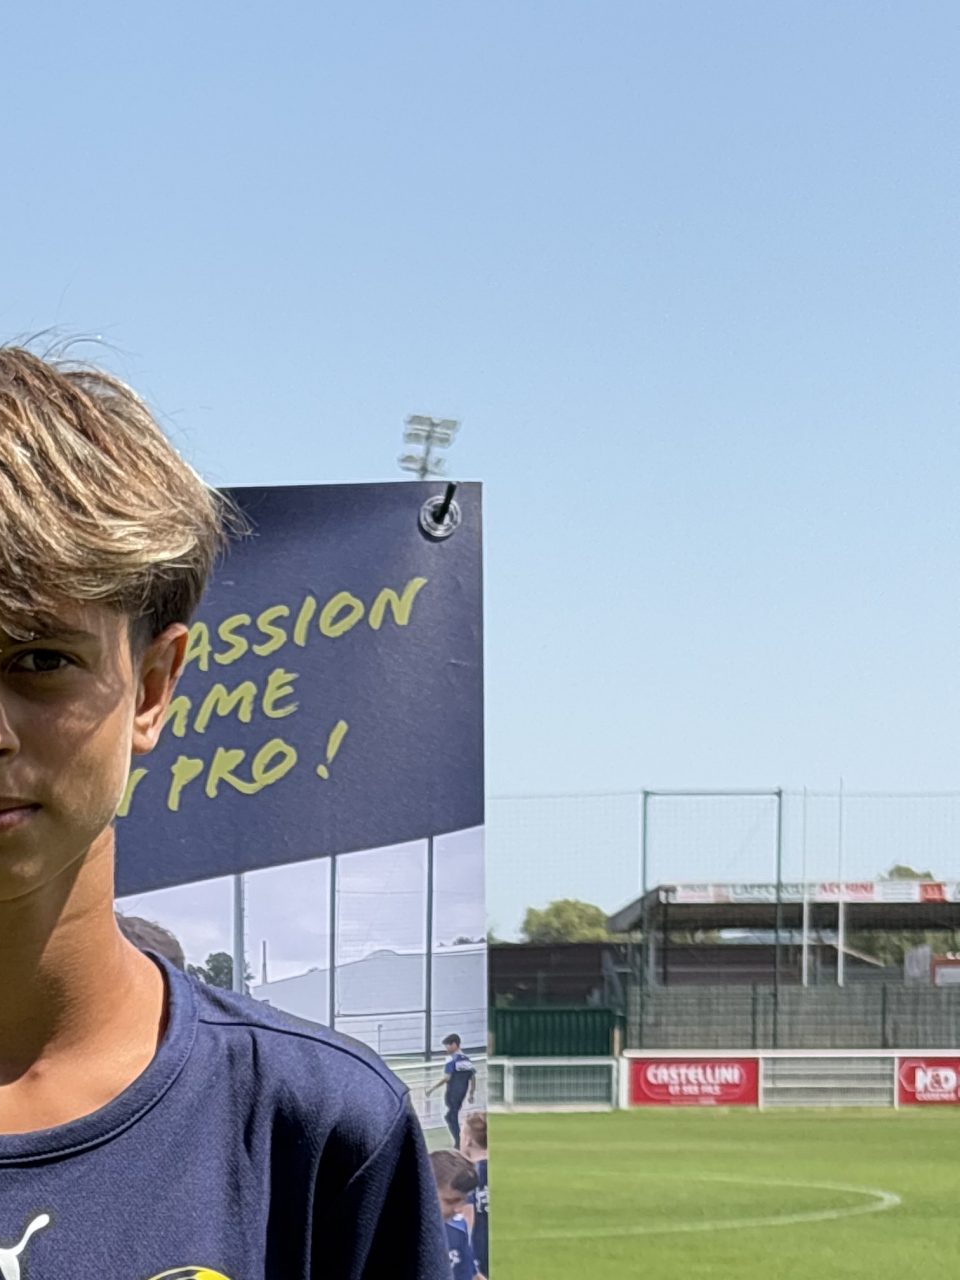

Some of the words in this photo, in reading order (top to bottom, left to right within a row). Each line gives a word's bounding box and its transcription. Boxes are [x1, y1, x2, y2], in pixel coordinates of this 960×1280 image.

[167, 738, 298, 812] PRO
[316, 719, 349, 780] !
[646, 1063, 741, 1084] CASTELLINI
